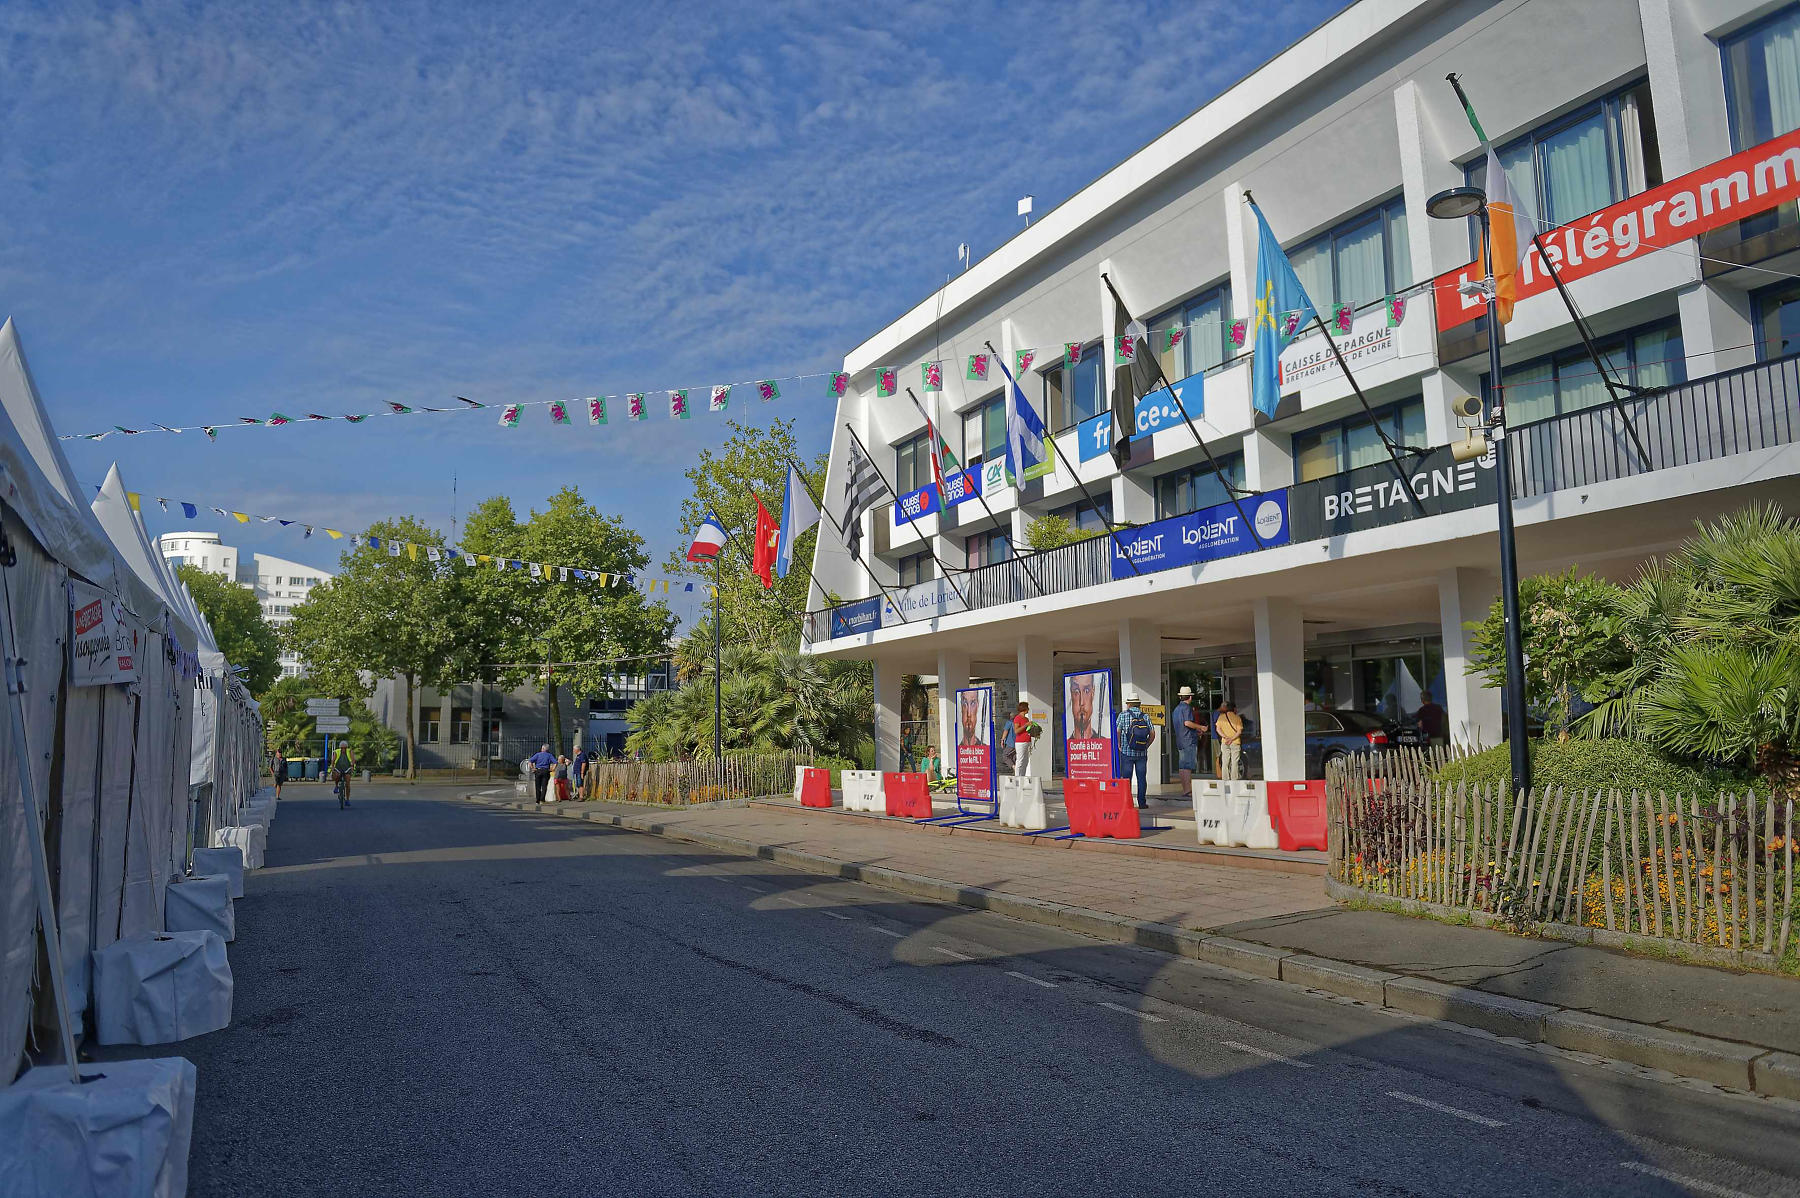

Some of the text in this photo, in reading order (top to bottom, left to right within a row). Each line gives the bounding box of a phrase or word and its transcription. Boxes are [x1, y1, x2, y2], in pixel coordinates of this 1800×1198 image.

[1285, 327, 1392, 373] CAISSE DEPARGNE
[1285, 340, 1392, 384] BRETAGNE PAS DE LOIRE
[1324, 461, 1477, 521] BRETAGNE
[902, 492, 920, 509] ouest
[919, 594, 929, 608] de
[1091, 741, 1103, 750] bloc
[1070, 753, 1082, 762] pour
[1082, 752, 1088, 760] le
[1088, 752, 1096, 760] FIL
[1203, 819, 1220, 829] VLT
